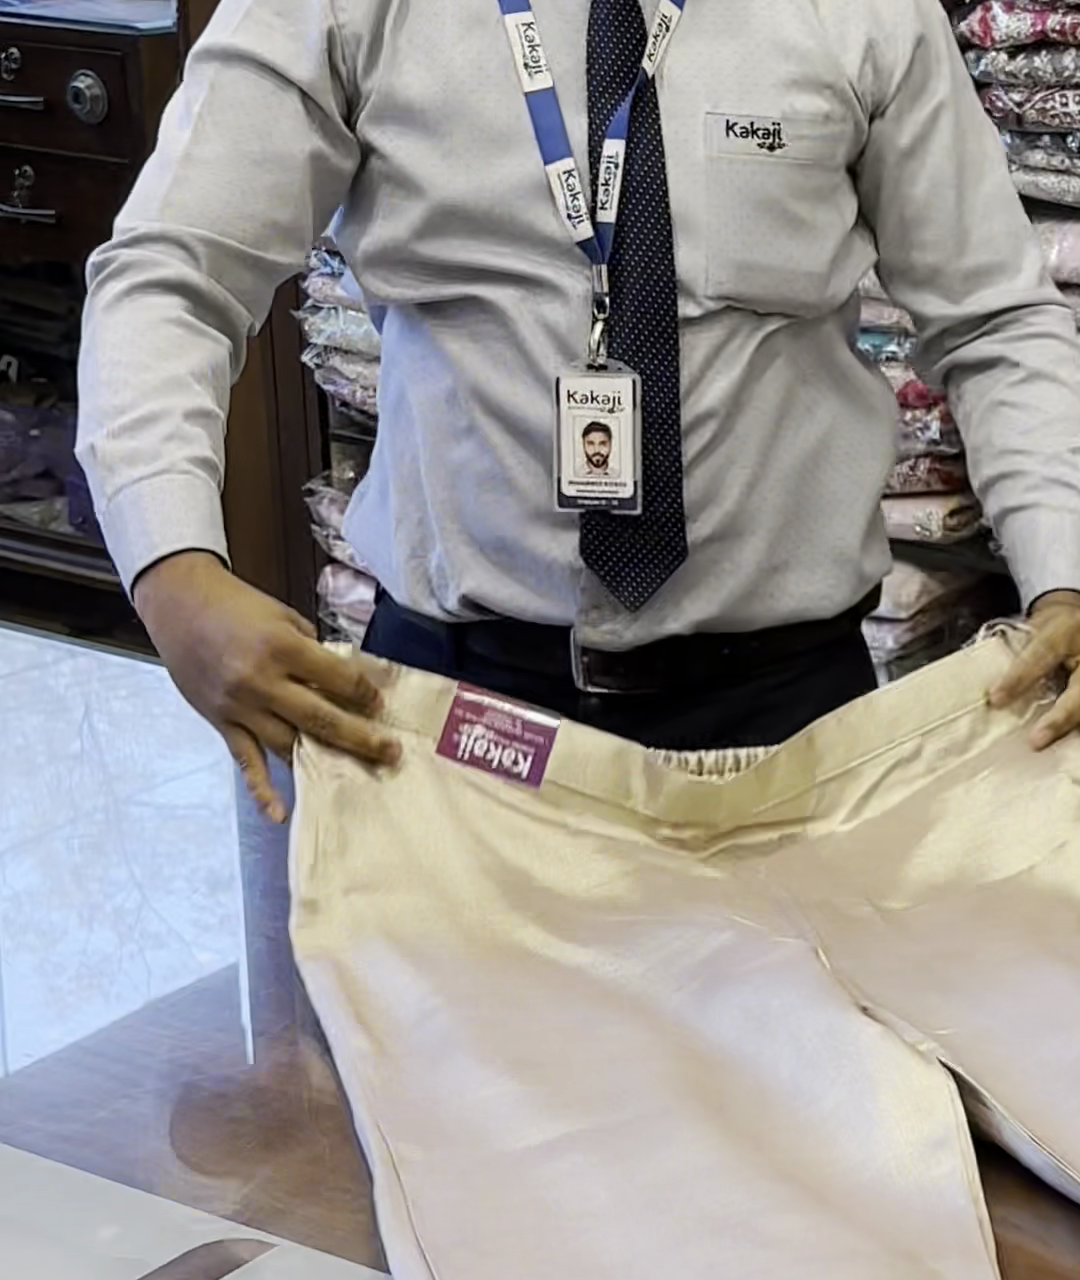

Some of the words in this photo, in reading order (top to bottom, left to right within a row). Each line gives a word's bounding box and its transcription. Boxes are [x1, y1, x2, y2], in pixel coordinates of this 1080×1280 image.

[521, 21, 551, 74] Kakaji
[647, 10, 670, 63] Kakaji
[725, 119, 783, 144] Kakaji
[562, 168, 590, 225] Kakaji
[599, 154, 619, 210] Kakaji
[567, 389, 622, 410] Kakaji
